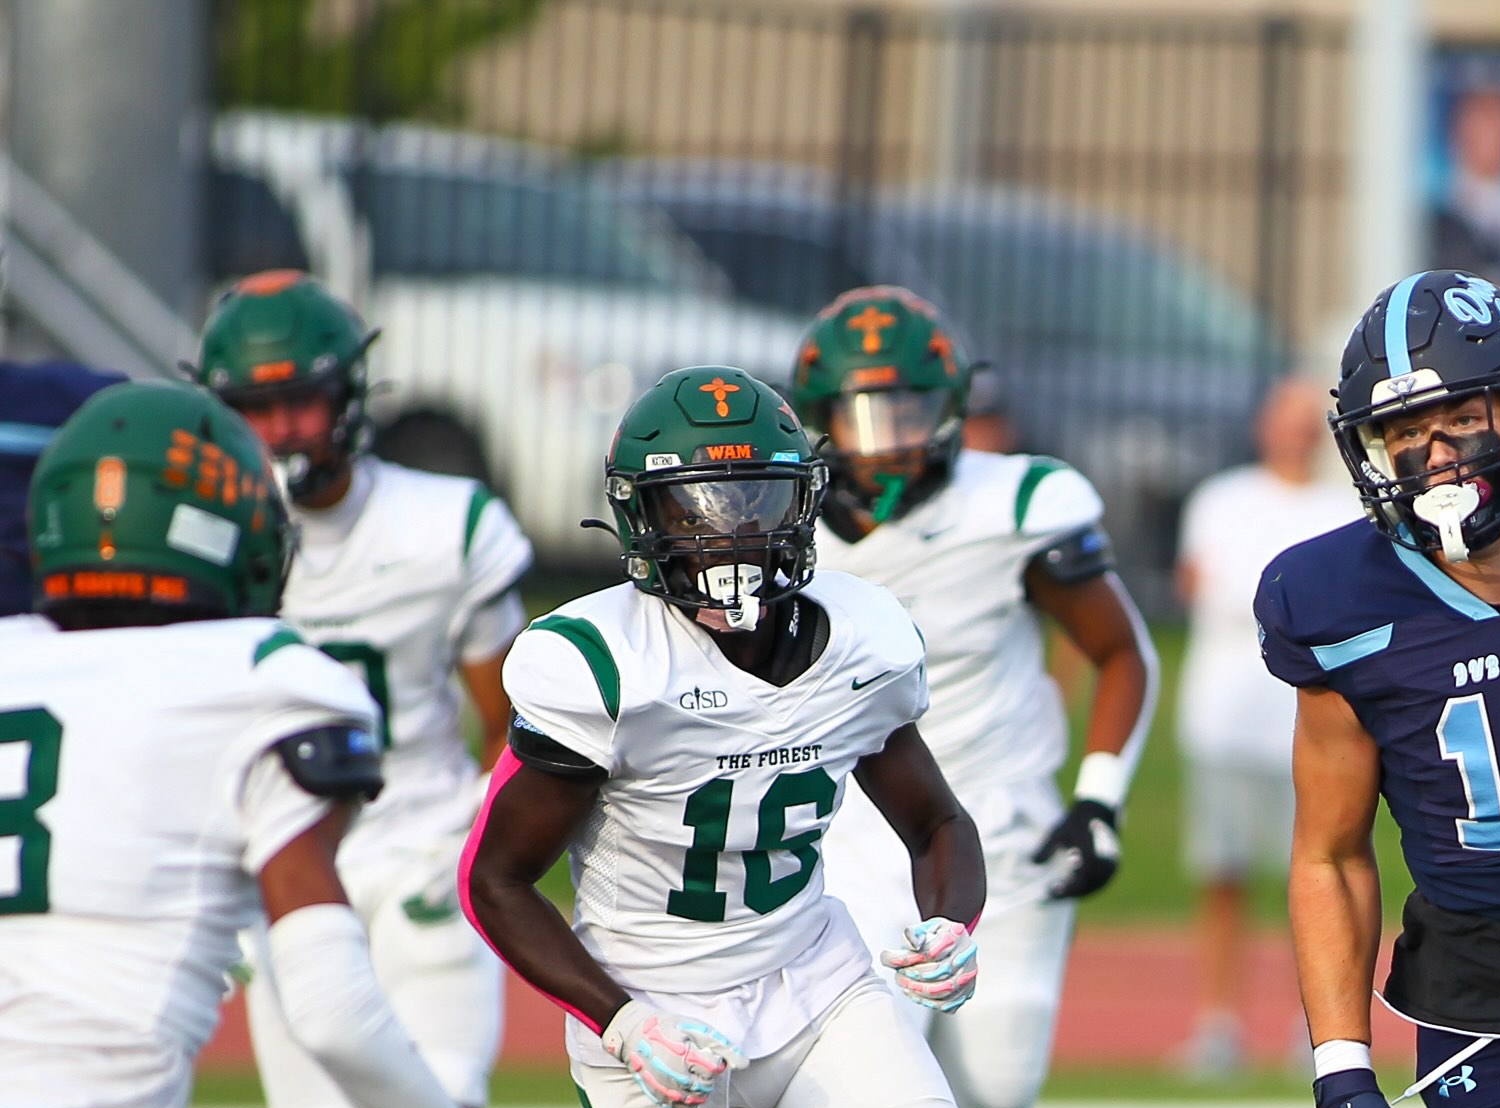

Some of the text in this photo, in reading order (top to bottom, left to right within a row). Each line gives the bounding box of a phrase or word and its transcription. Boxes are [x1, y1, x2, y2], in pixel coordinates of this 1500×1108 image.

[706, 445, 752, 461] WAM
[1453, 654, 1500, 687] DUB
[716, 744, 822, 769] THE FOREST
[666, 766, 838, 923] 16
